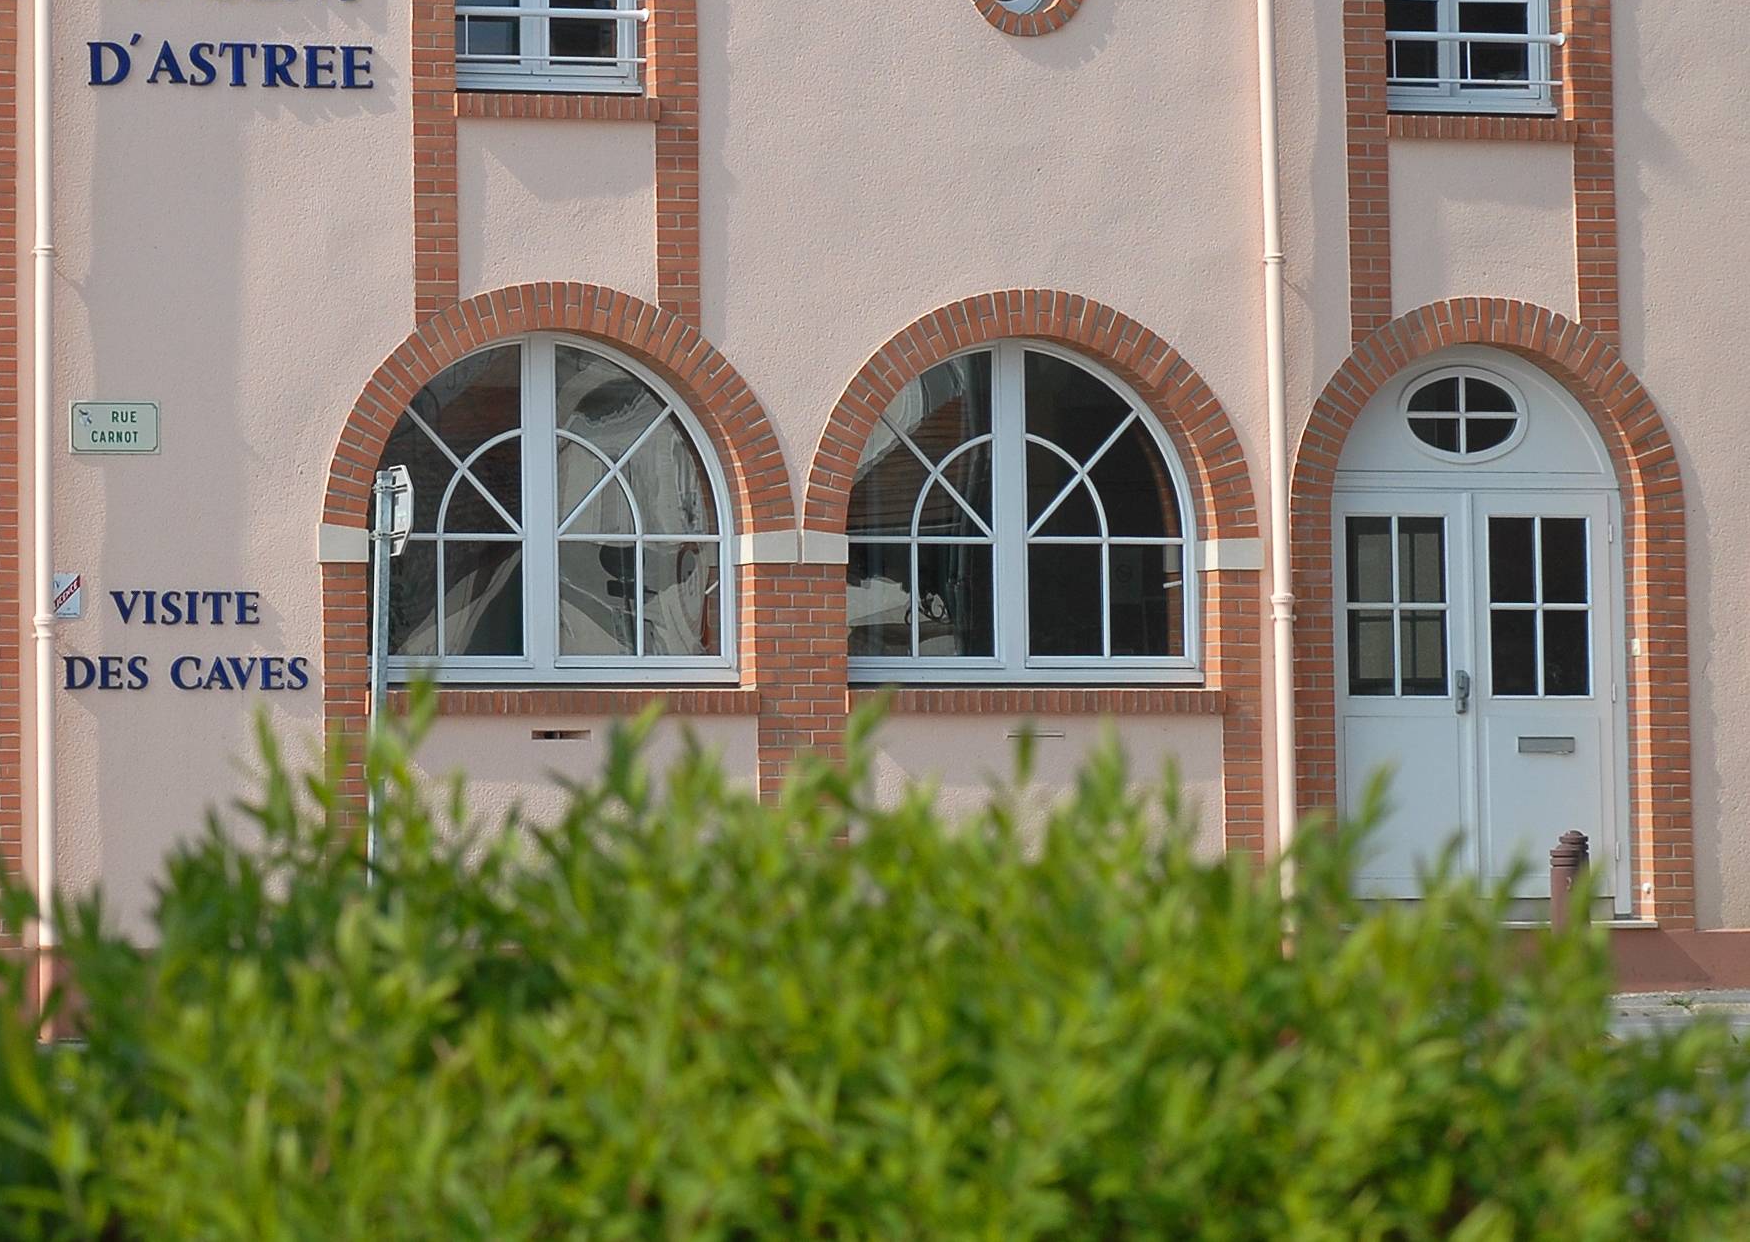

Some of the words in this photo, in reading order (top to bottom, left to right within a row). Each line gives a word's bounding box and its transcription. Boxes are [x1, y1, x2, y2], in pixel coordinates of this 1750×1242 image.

[87, 33, 374, 90] D'ASTREE
[111, 410, 138, 424] RUE
[91, 430, 139, 444] CARNOT
[109, 590, 261, 625] VISITE
[63, 656, 150, 690] DES
[170, 655, 309, 690] CAVES
